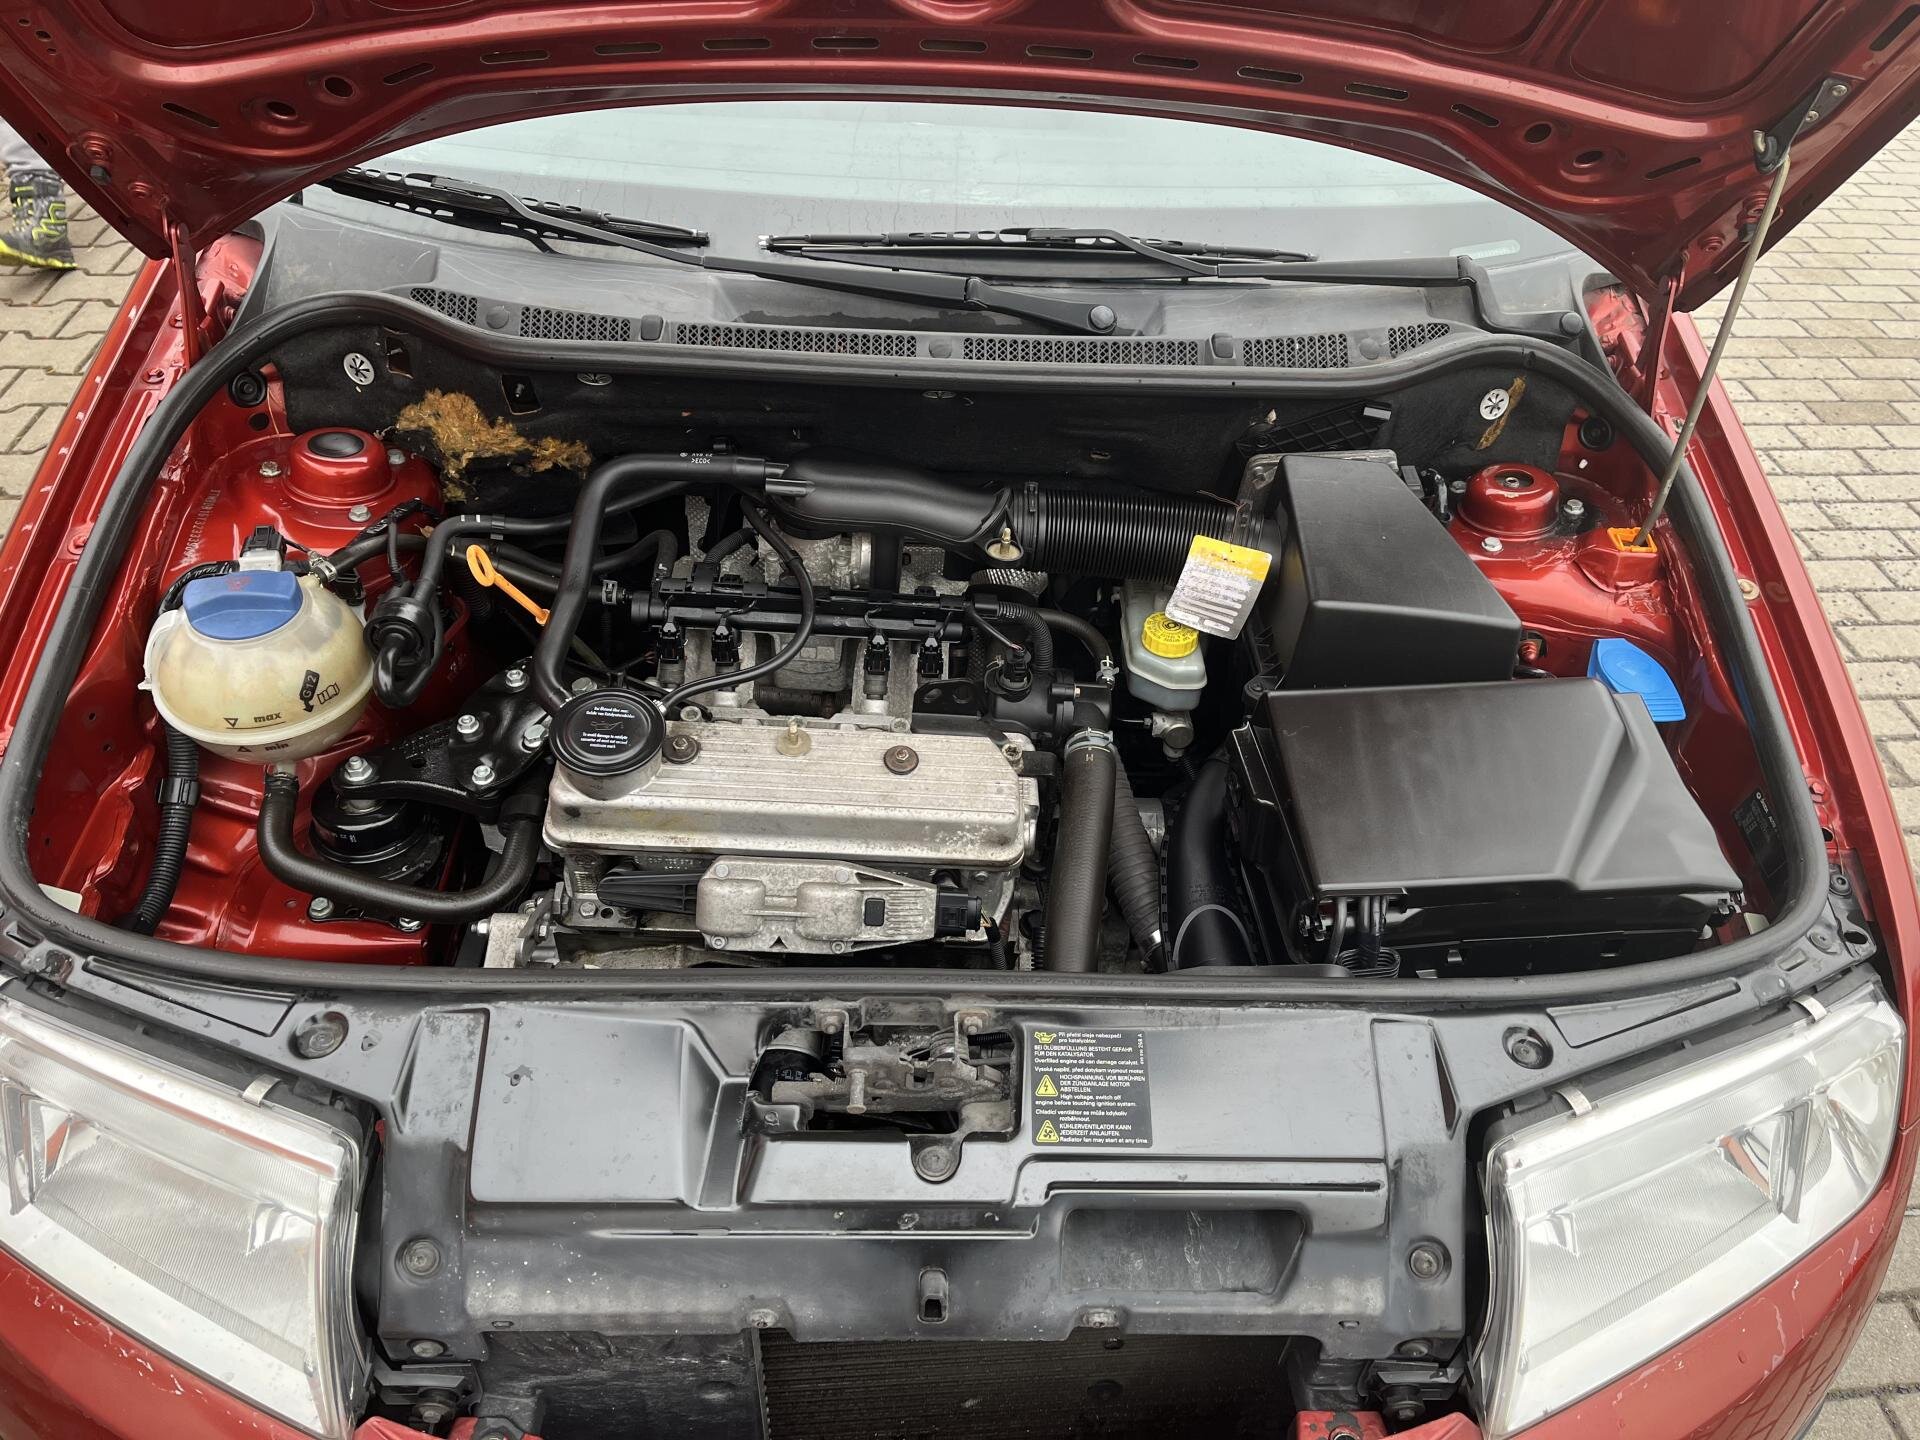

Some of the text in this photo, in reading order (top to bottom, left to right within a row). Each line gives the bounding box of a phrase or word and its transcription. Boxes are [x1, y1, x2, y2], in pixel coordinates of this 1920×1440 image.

[302, 674, 317, 697] G12
[253, 712, 282, 723] max
[264, 742, 289, 752] min
